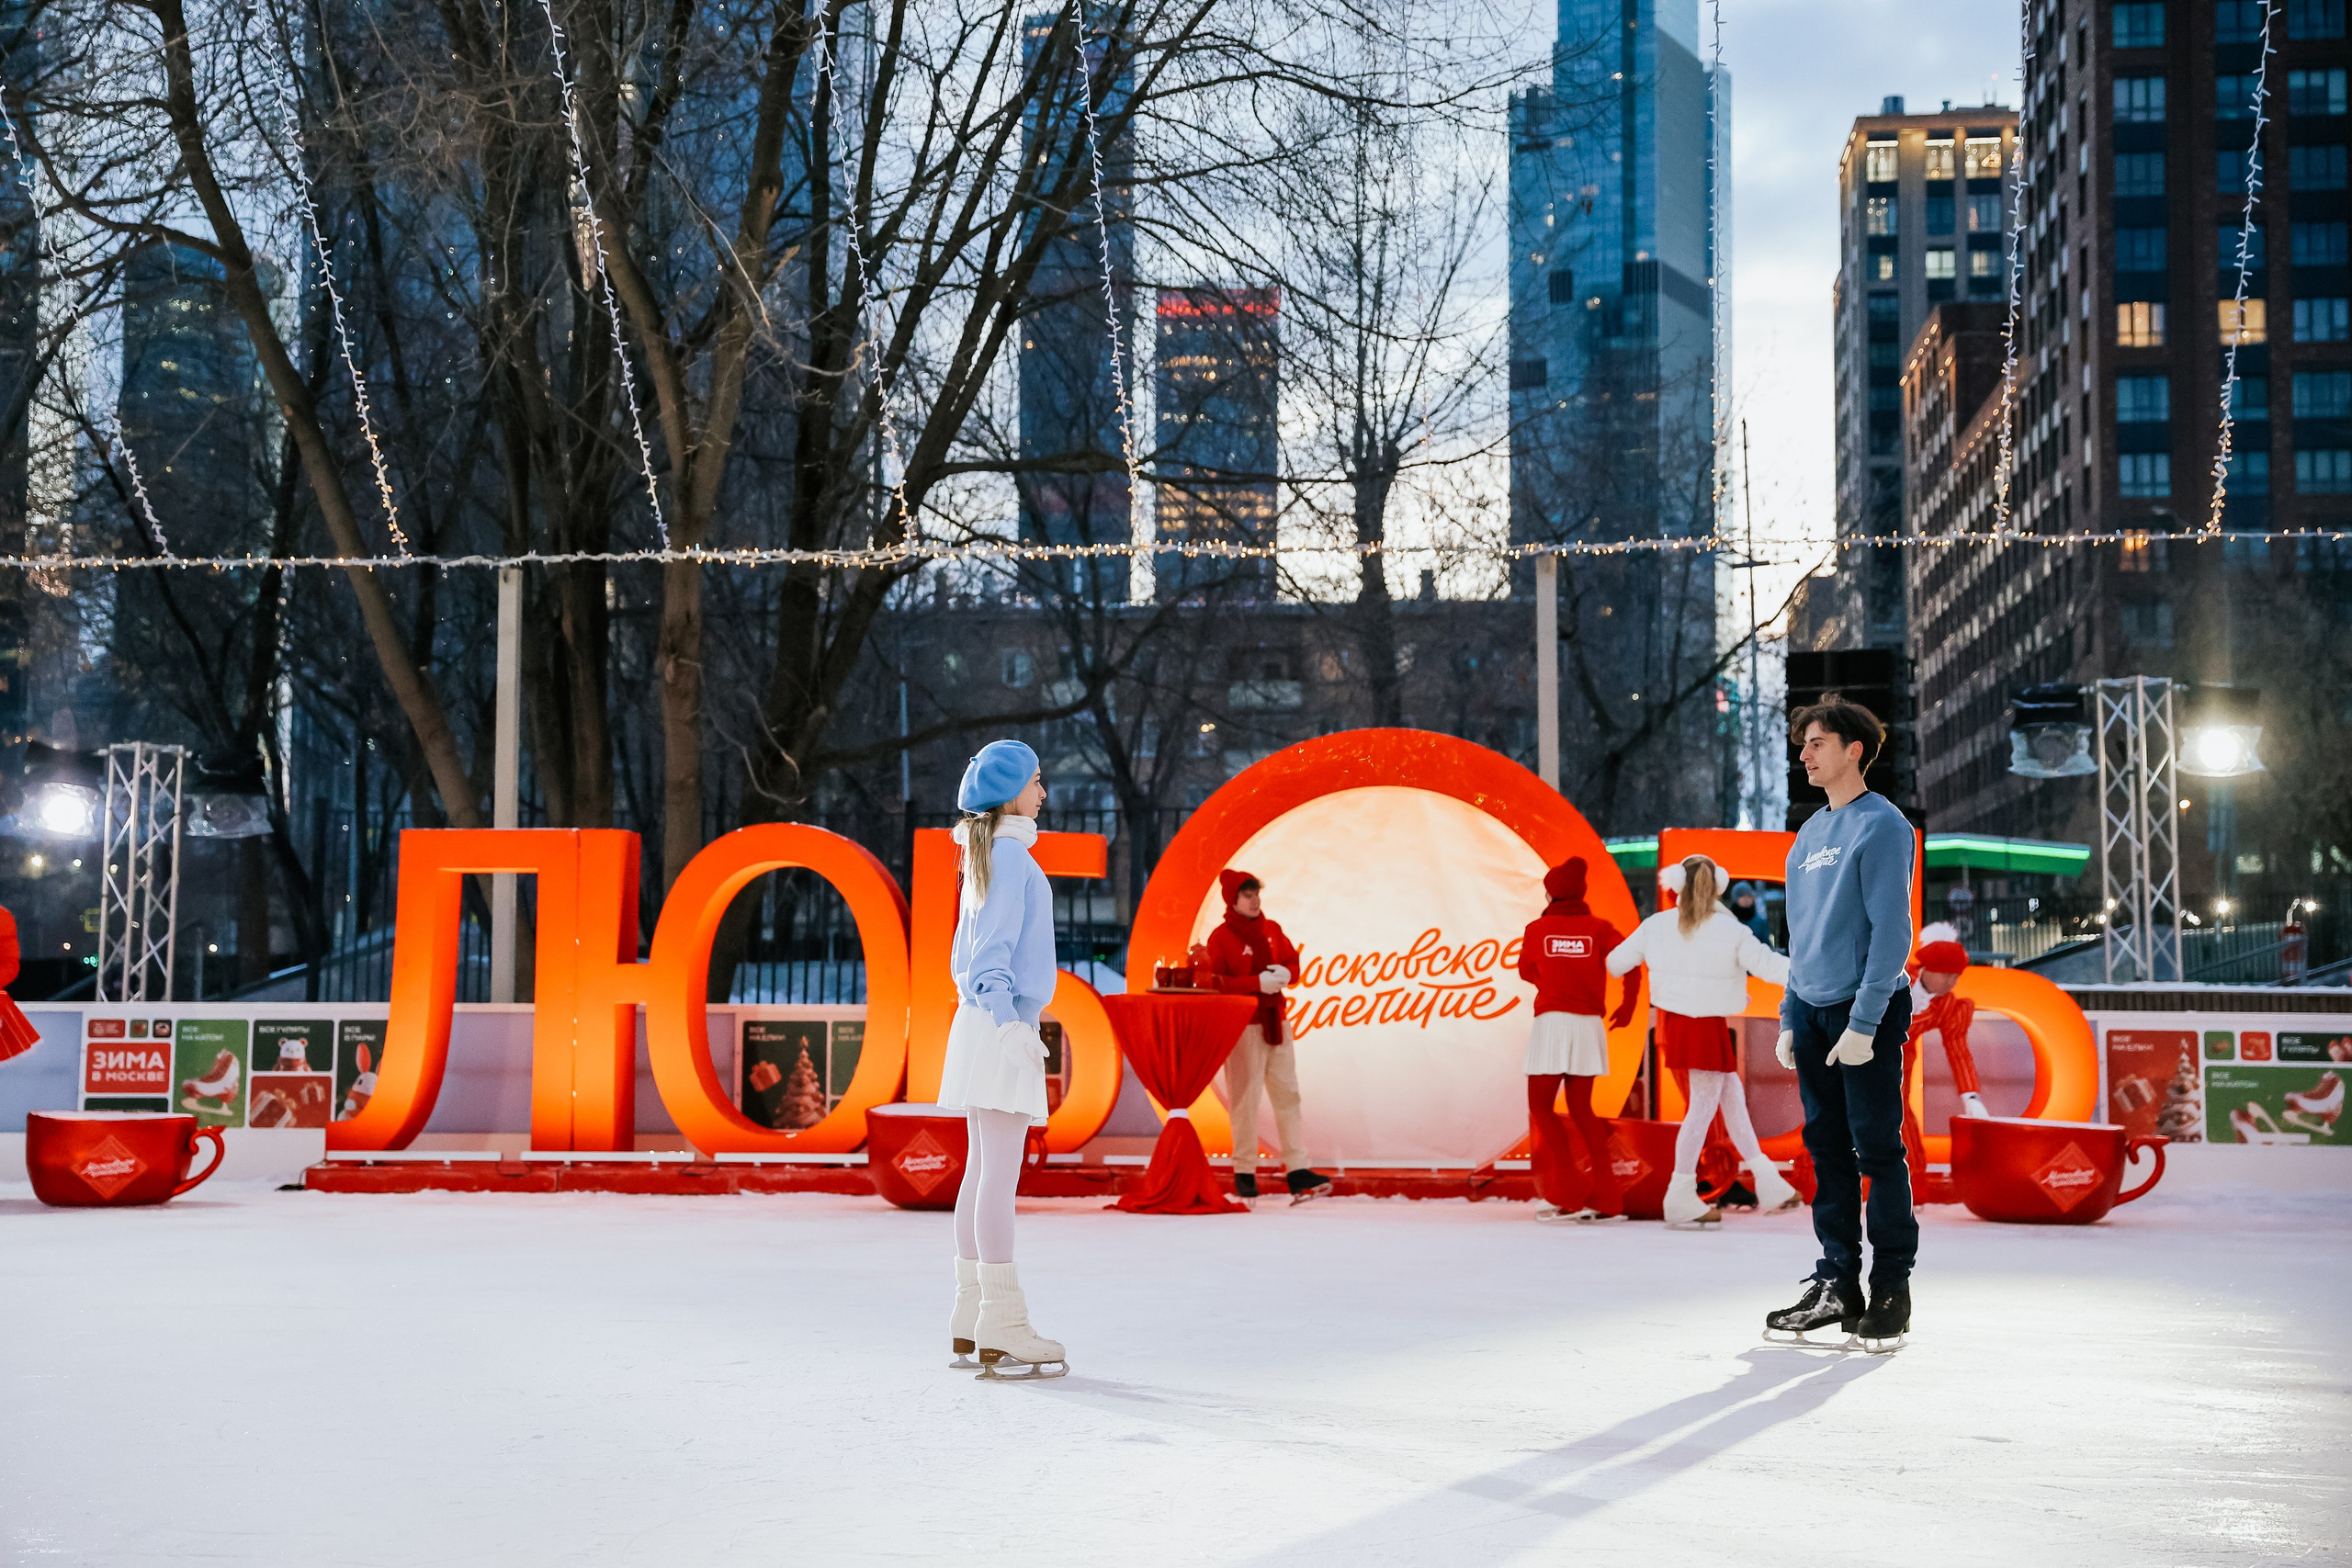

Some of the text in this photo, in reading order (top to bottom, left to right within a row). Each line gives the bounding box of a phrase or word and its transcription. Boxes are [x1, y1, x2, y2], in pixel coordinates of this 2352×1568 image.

[92, 1050, 166, 1070] ЗИМА
[91, 1070, 165, 1082] В МОСКВЕ
